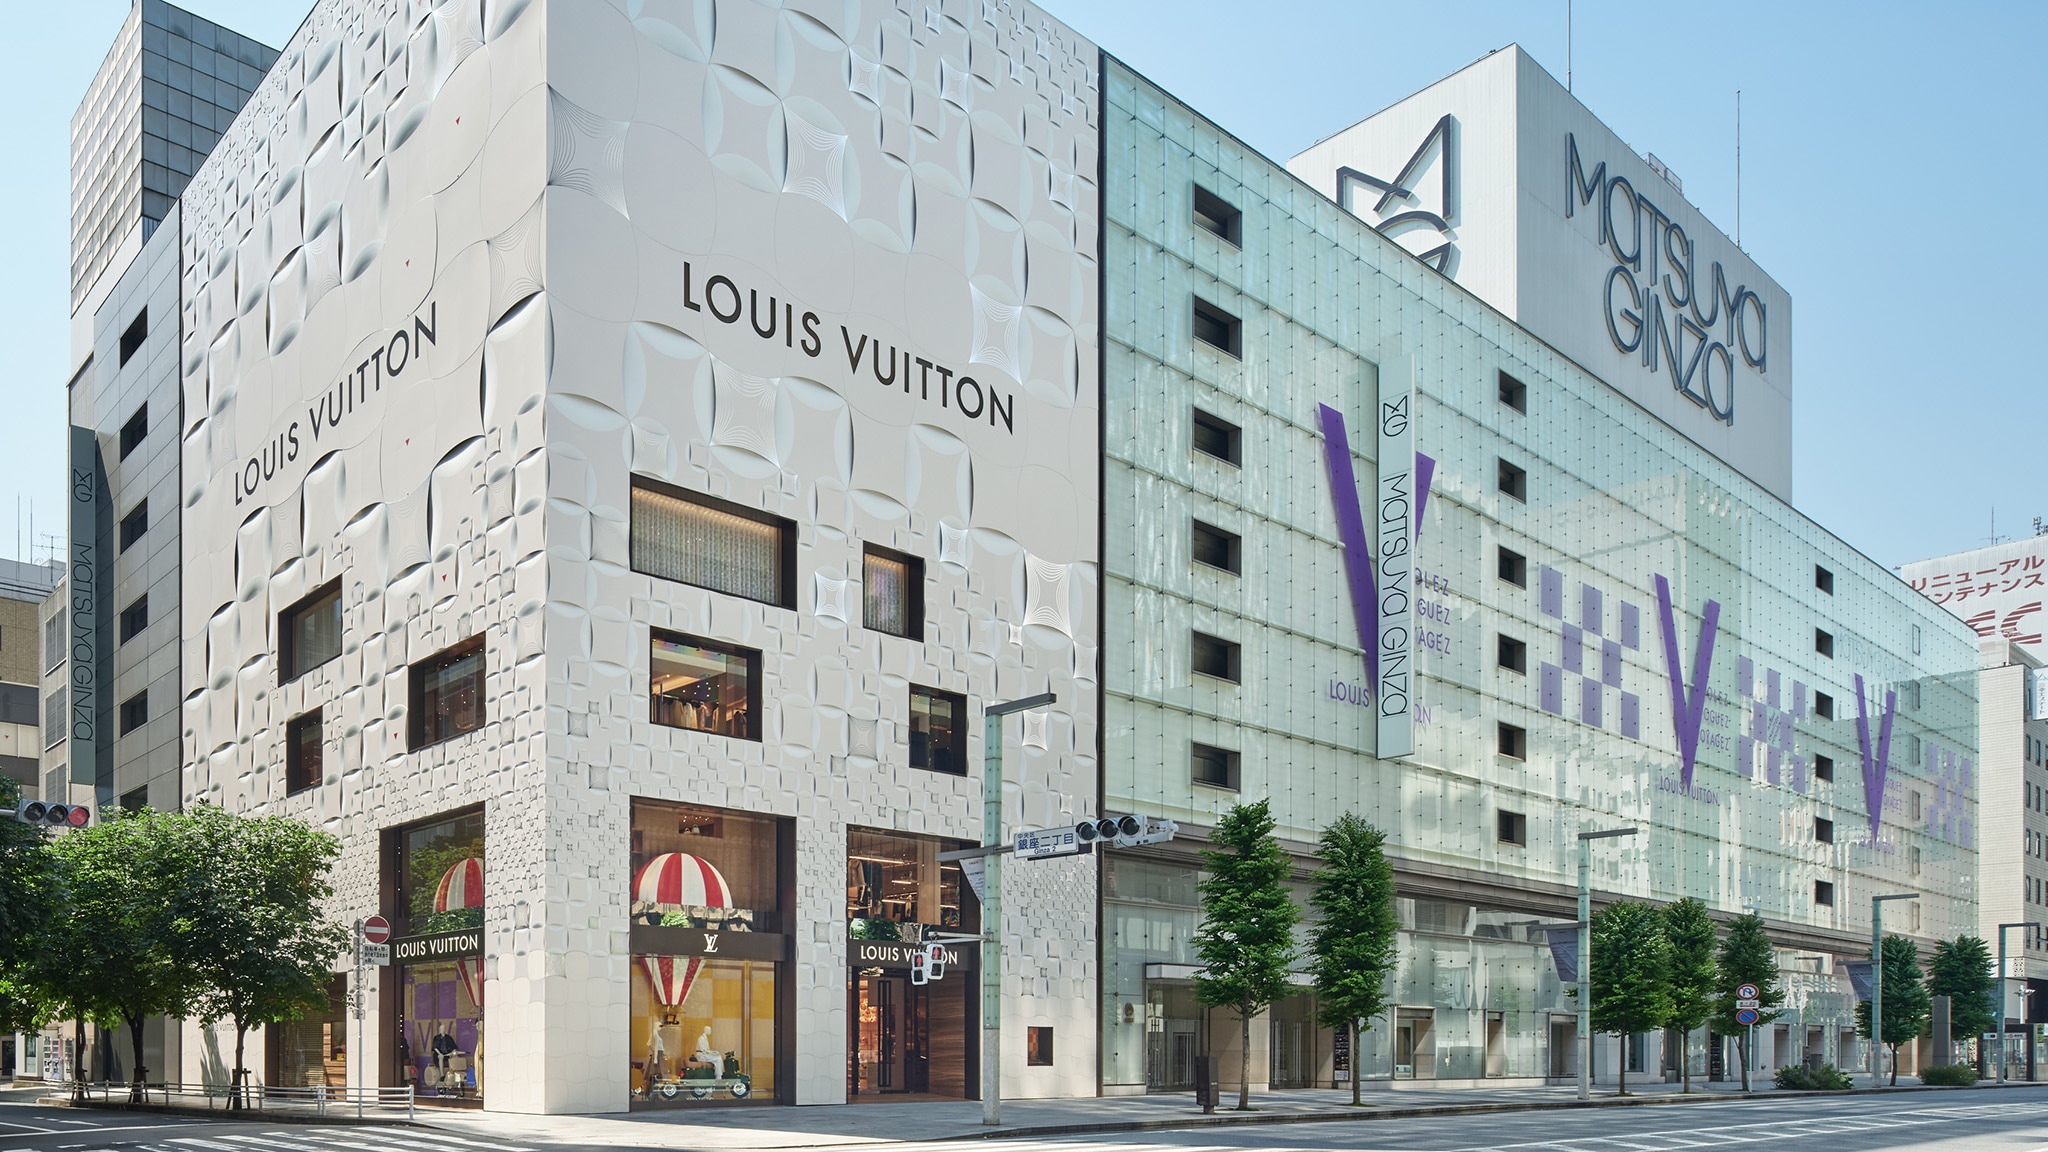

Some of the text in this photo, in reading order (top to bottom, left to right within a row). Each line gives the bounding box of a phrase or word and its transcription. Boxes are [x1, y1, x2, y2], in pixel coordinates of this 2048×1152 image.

[683, 261, 1014, 436] LOUIS VUITTON
[235, 300, 437, 507] LOUIS VUITTON
[1911, 555, 2045, 592] リニューアル
[1924, 573, 2045, 605] ンテナンス
[1417, 598, 1450, 625] GUEZ
[1414, 626, 1450, 655] AGEZ
[1329, 679, 1370, 708] LOUIS
[1660, 775, 1684, 796] LOUIS
[1018, 833, 1074, 850] 銀座二丁目
[1034, 847, 1051, 855] Ginza
[396, 934, 478, 958] LOUIS VUITTON
[860, 945, 899, 961] LOUIS
